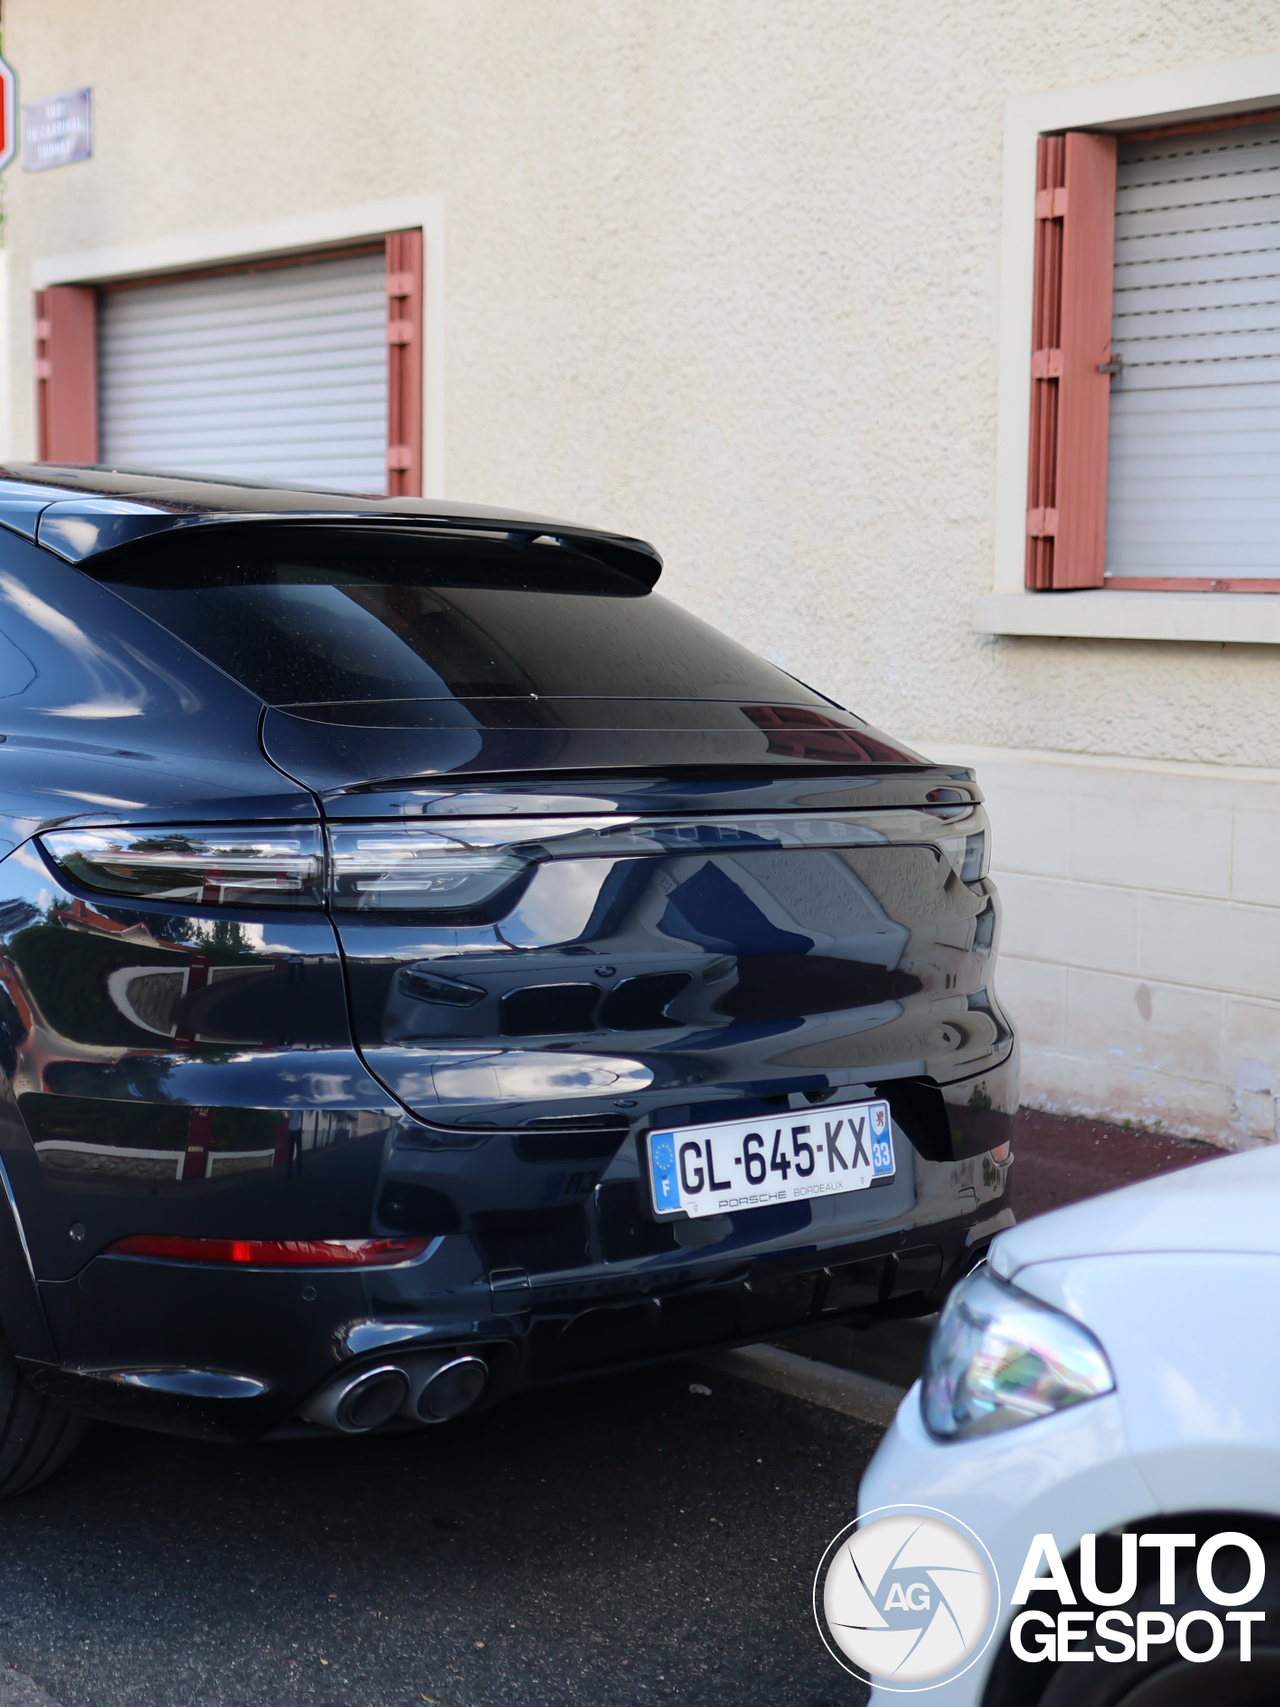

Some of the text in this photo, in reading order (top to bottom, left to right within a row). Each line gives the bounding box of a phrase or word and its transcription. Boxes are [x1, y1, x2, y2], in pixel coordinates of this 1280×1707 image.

[26, 117, 82, 142] DU CARDINAL
[661, 1116, 891, 1197] F GL-645-KX 33
[717, 1181, 844, 1209] PORSCHE BORDEAUX
